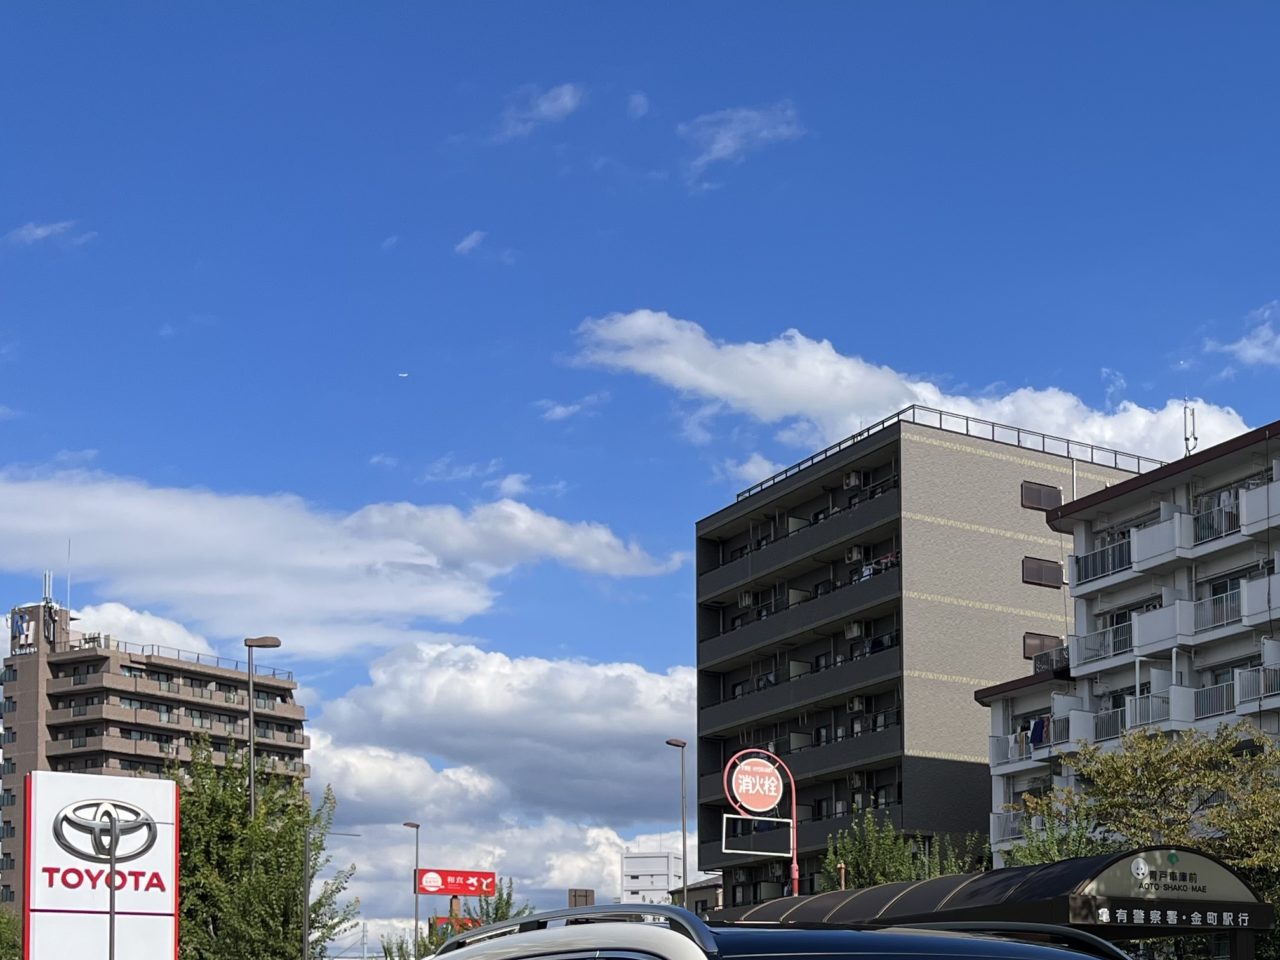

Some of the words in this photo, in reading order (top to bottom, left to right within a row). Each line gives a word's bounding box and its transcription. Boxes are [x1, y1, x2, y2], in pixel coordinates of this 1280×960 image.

[738, 774, 778, 796] 消火栓
[42, 867, 166, 893] TOYOTA
